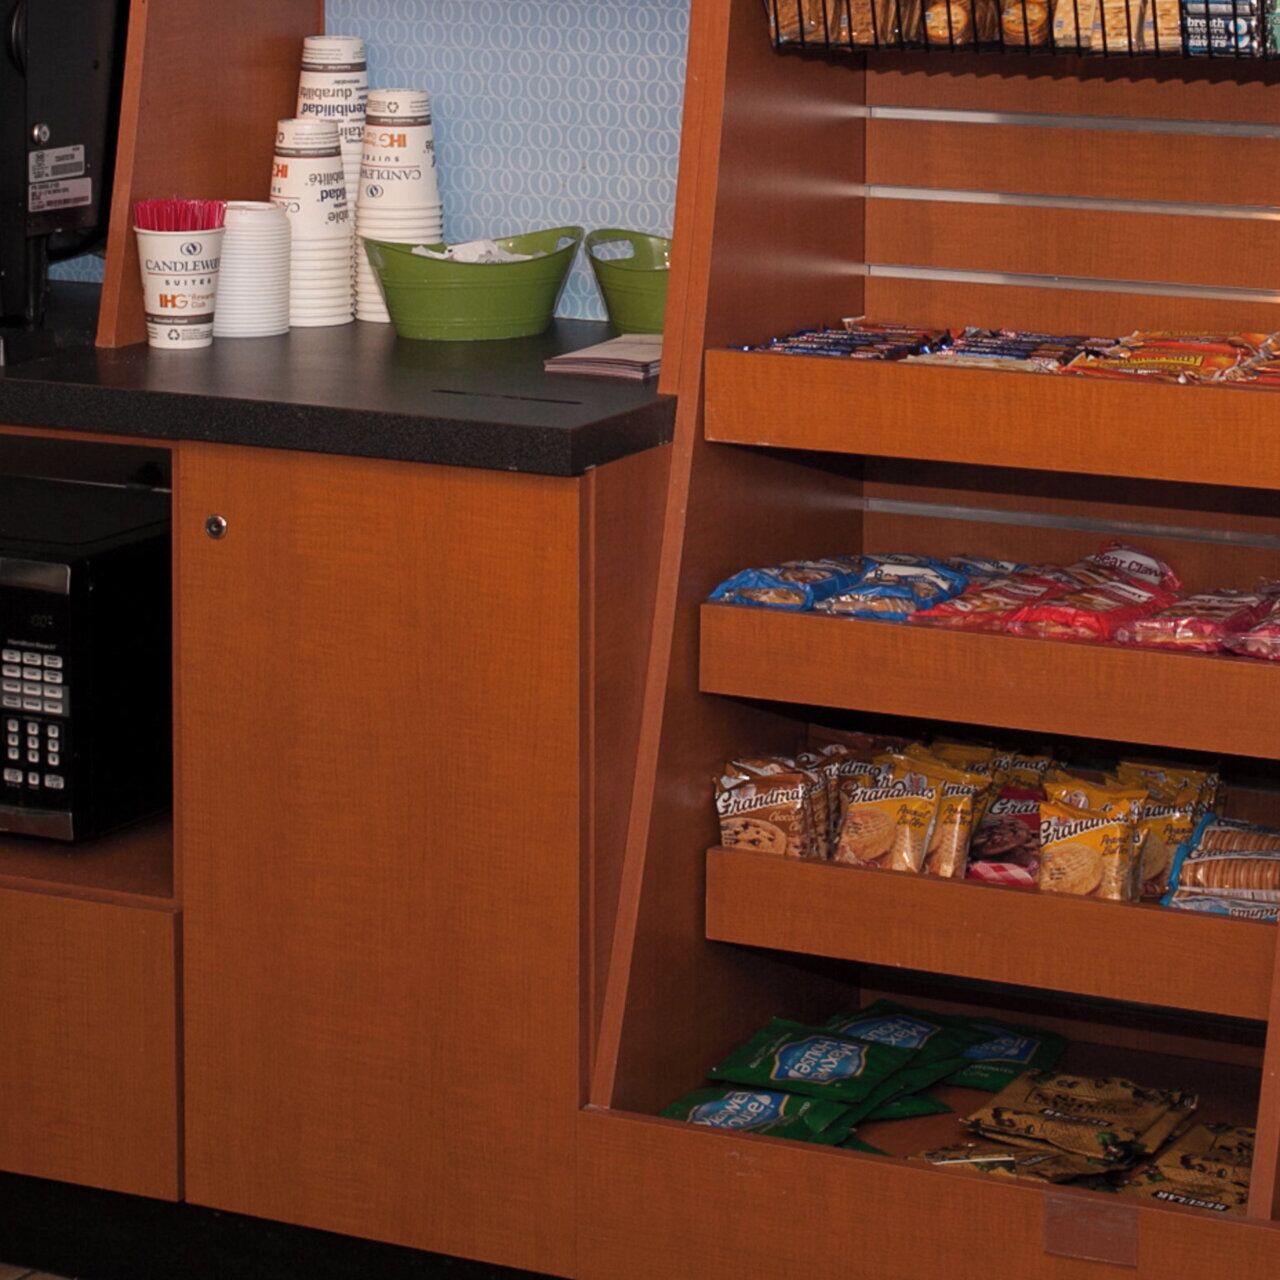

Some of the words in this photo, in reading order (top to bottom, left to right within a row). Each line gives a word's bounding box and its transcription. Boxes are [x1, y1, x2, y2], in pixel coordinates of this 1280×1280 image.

[379, 133, 407, 148] IHG
[165, 278, 212, 287] SUITES
[159, 293, 188, 309] IHG
[716, 783, 808, 815] Grandma's
